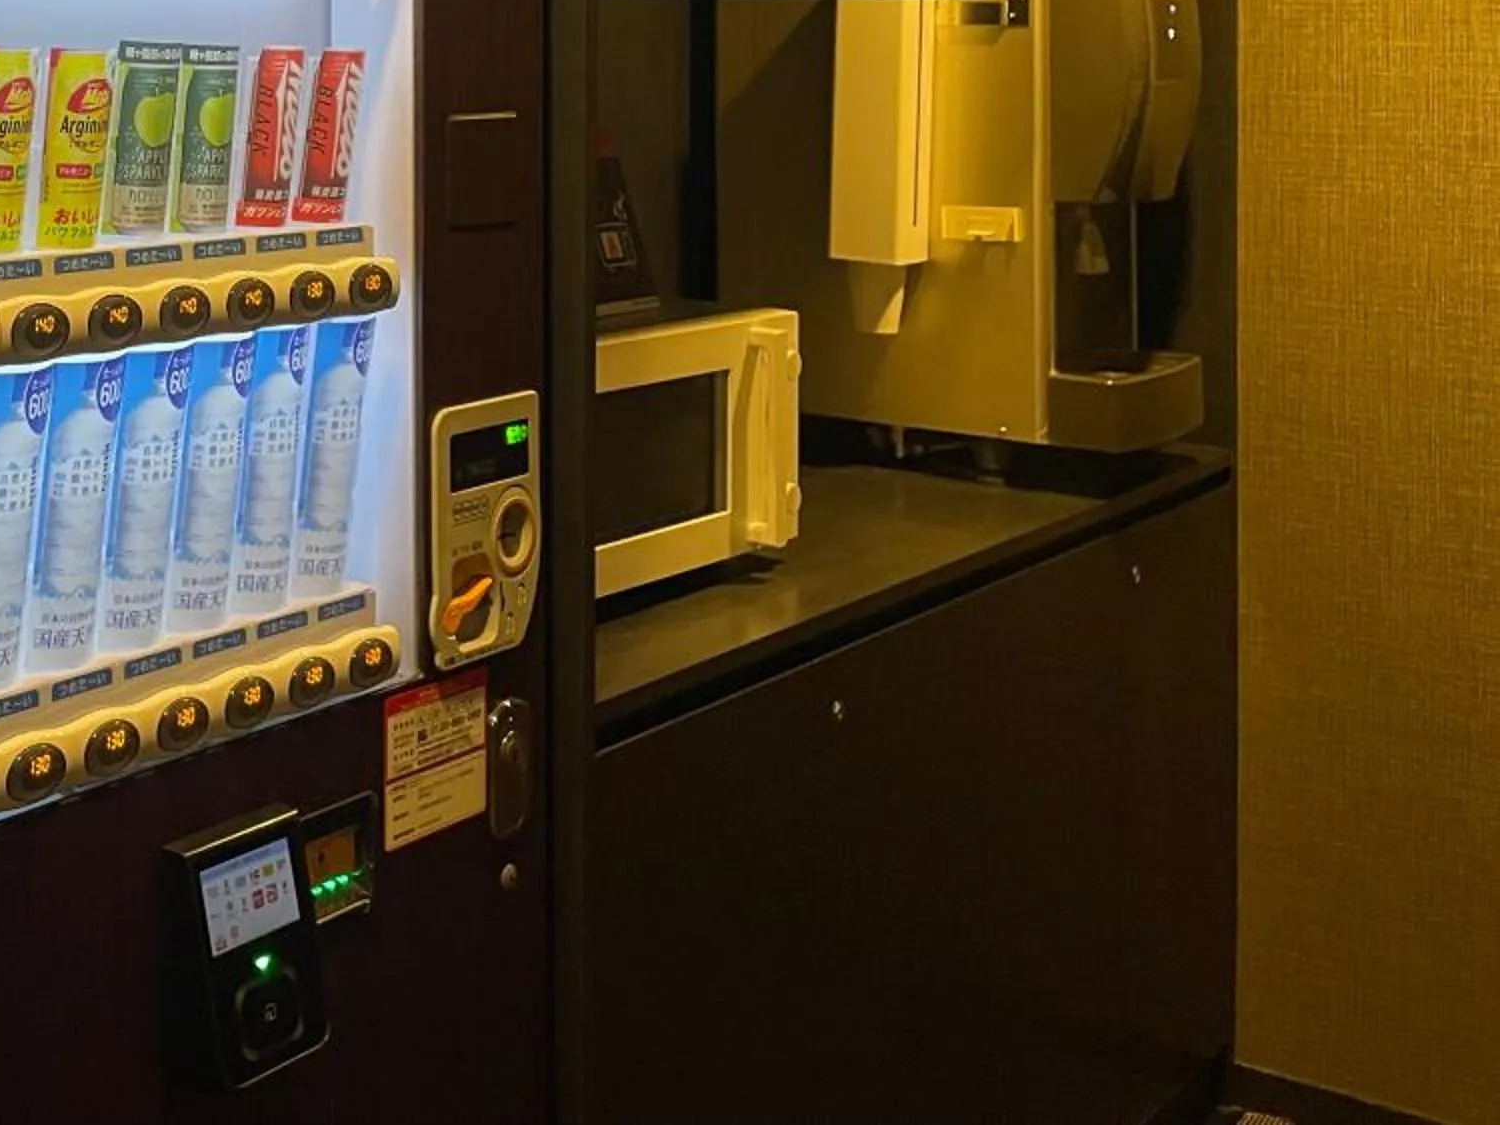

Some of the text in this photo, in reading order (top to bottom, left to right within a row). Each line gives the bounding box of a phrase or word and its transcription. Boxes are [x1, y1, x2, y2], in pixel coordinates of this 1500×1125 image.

[249, 83, 277, 154] BLACK
[310, 85, 336, 155] BLACK
[35, 315, 56, 334] 140
